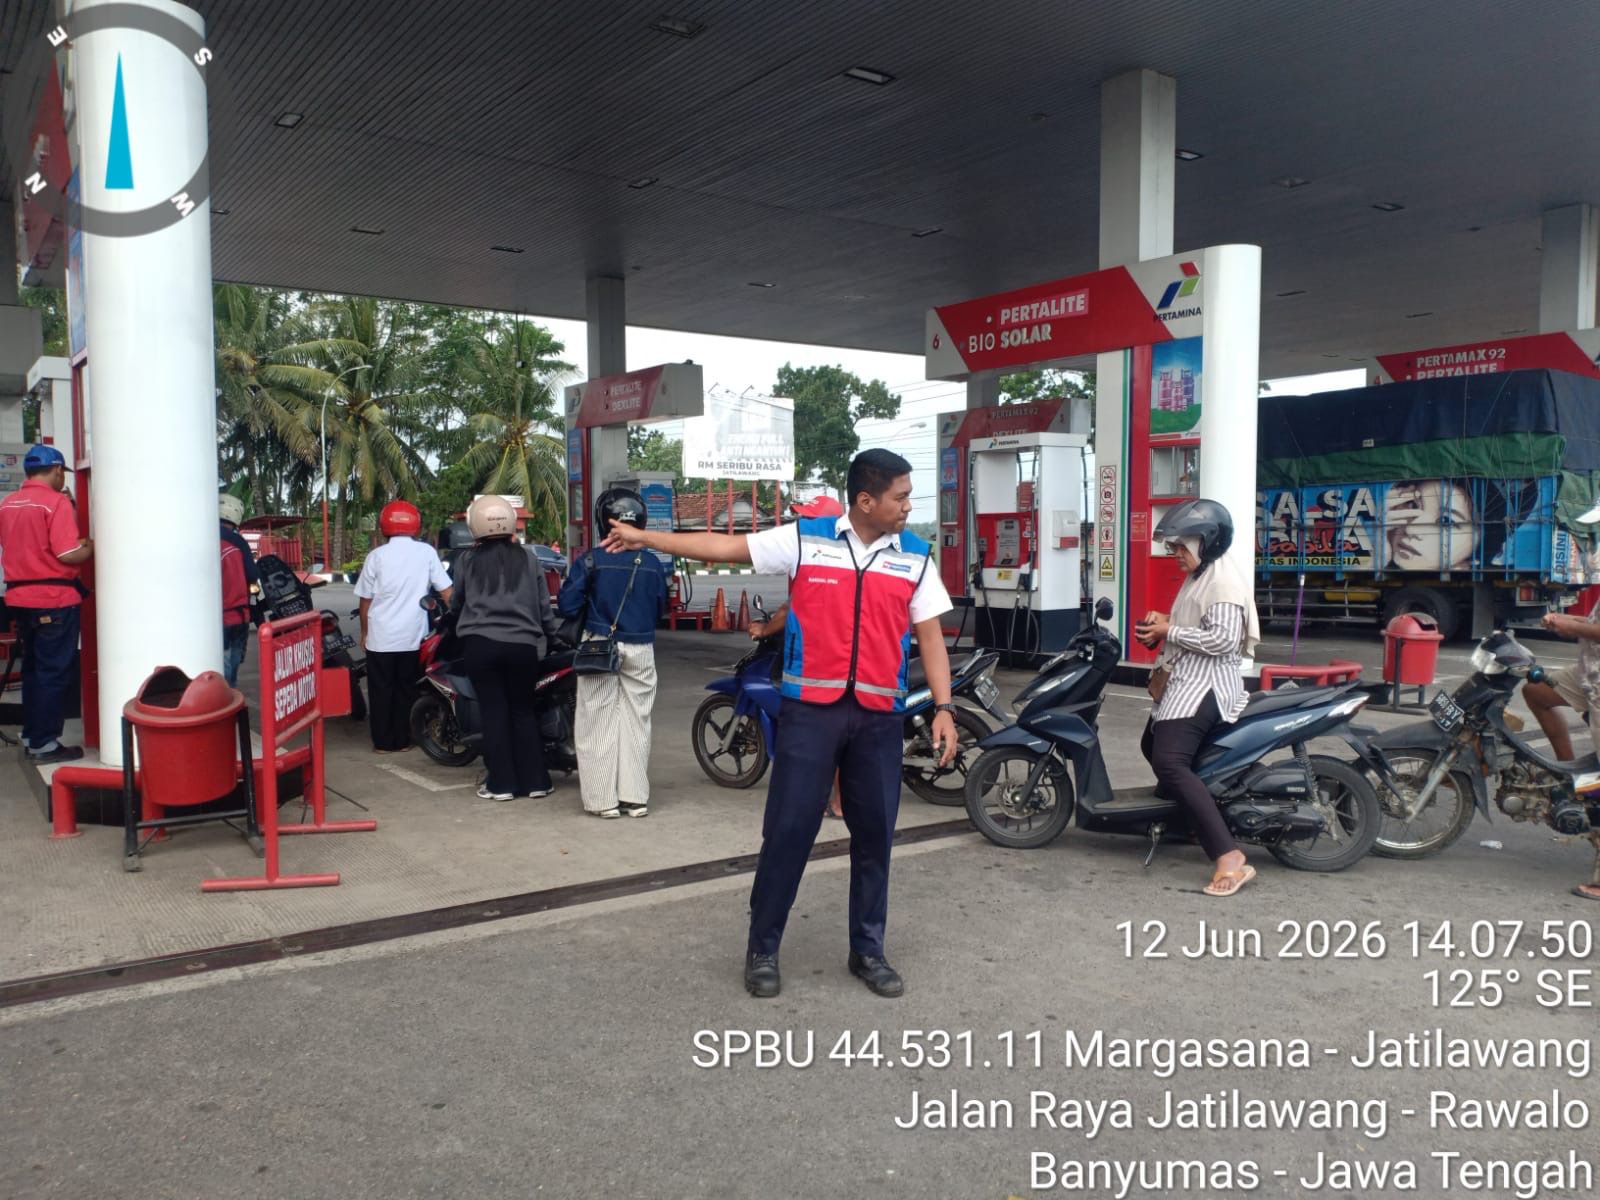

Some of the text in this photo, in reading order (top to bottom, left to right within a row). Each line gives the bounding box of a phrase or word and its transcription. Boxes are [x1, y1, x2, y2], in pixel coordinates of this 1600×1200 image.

[1000, 293, 1086, 325] PERTALITE
[1153, 307, 1203, 322] PERTAMINA
[968, 325, 1052, 353] BIO SOLAR
[1416, 348, 1506, 368] PERTAMAX 92
[1416, 363, 1497, 380] PERTALITE
[697, 461, 782, 471] RM SERIBU RASA
[1255, 487, 1377, 522] SASA
[1289, 557, 1361, 567] INDONESIA
[1555, 533, 1567, 576] DISINI
[275, 636, 315, 683] JALUR KHUSUS
[275, 672, 316, 721] SEPEDA MOTOR
